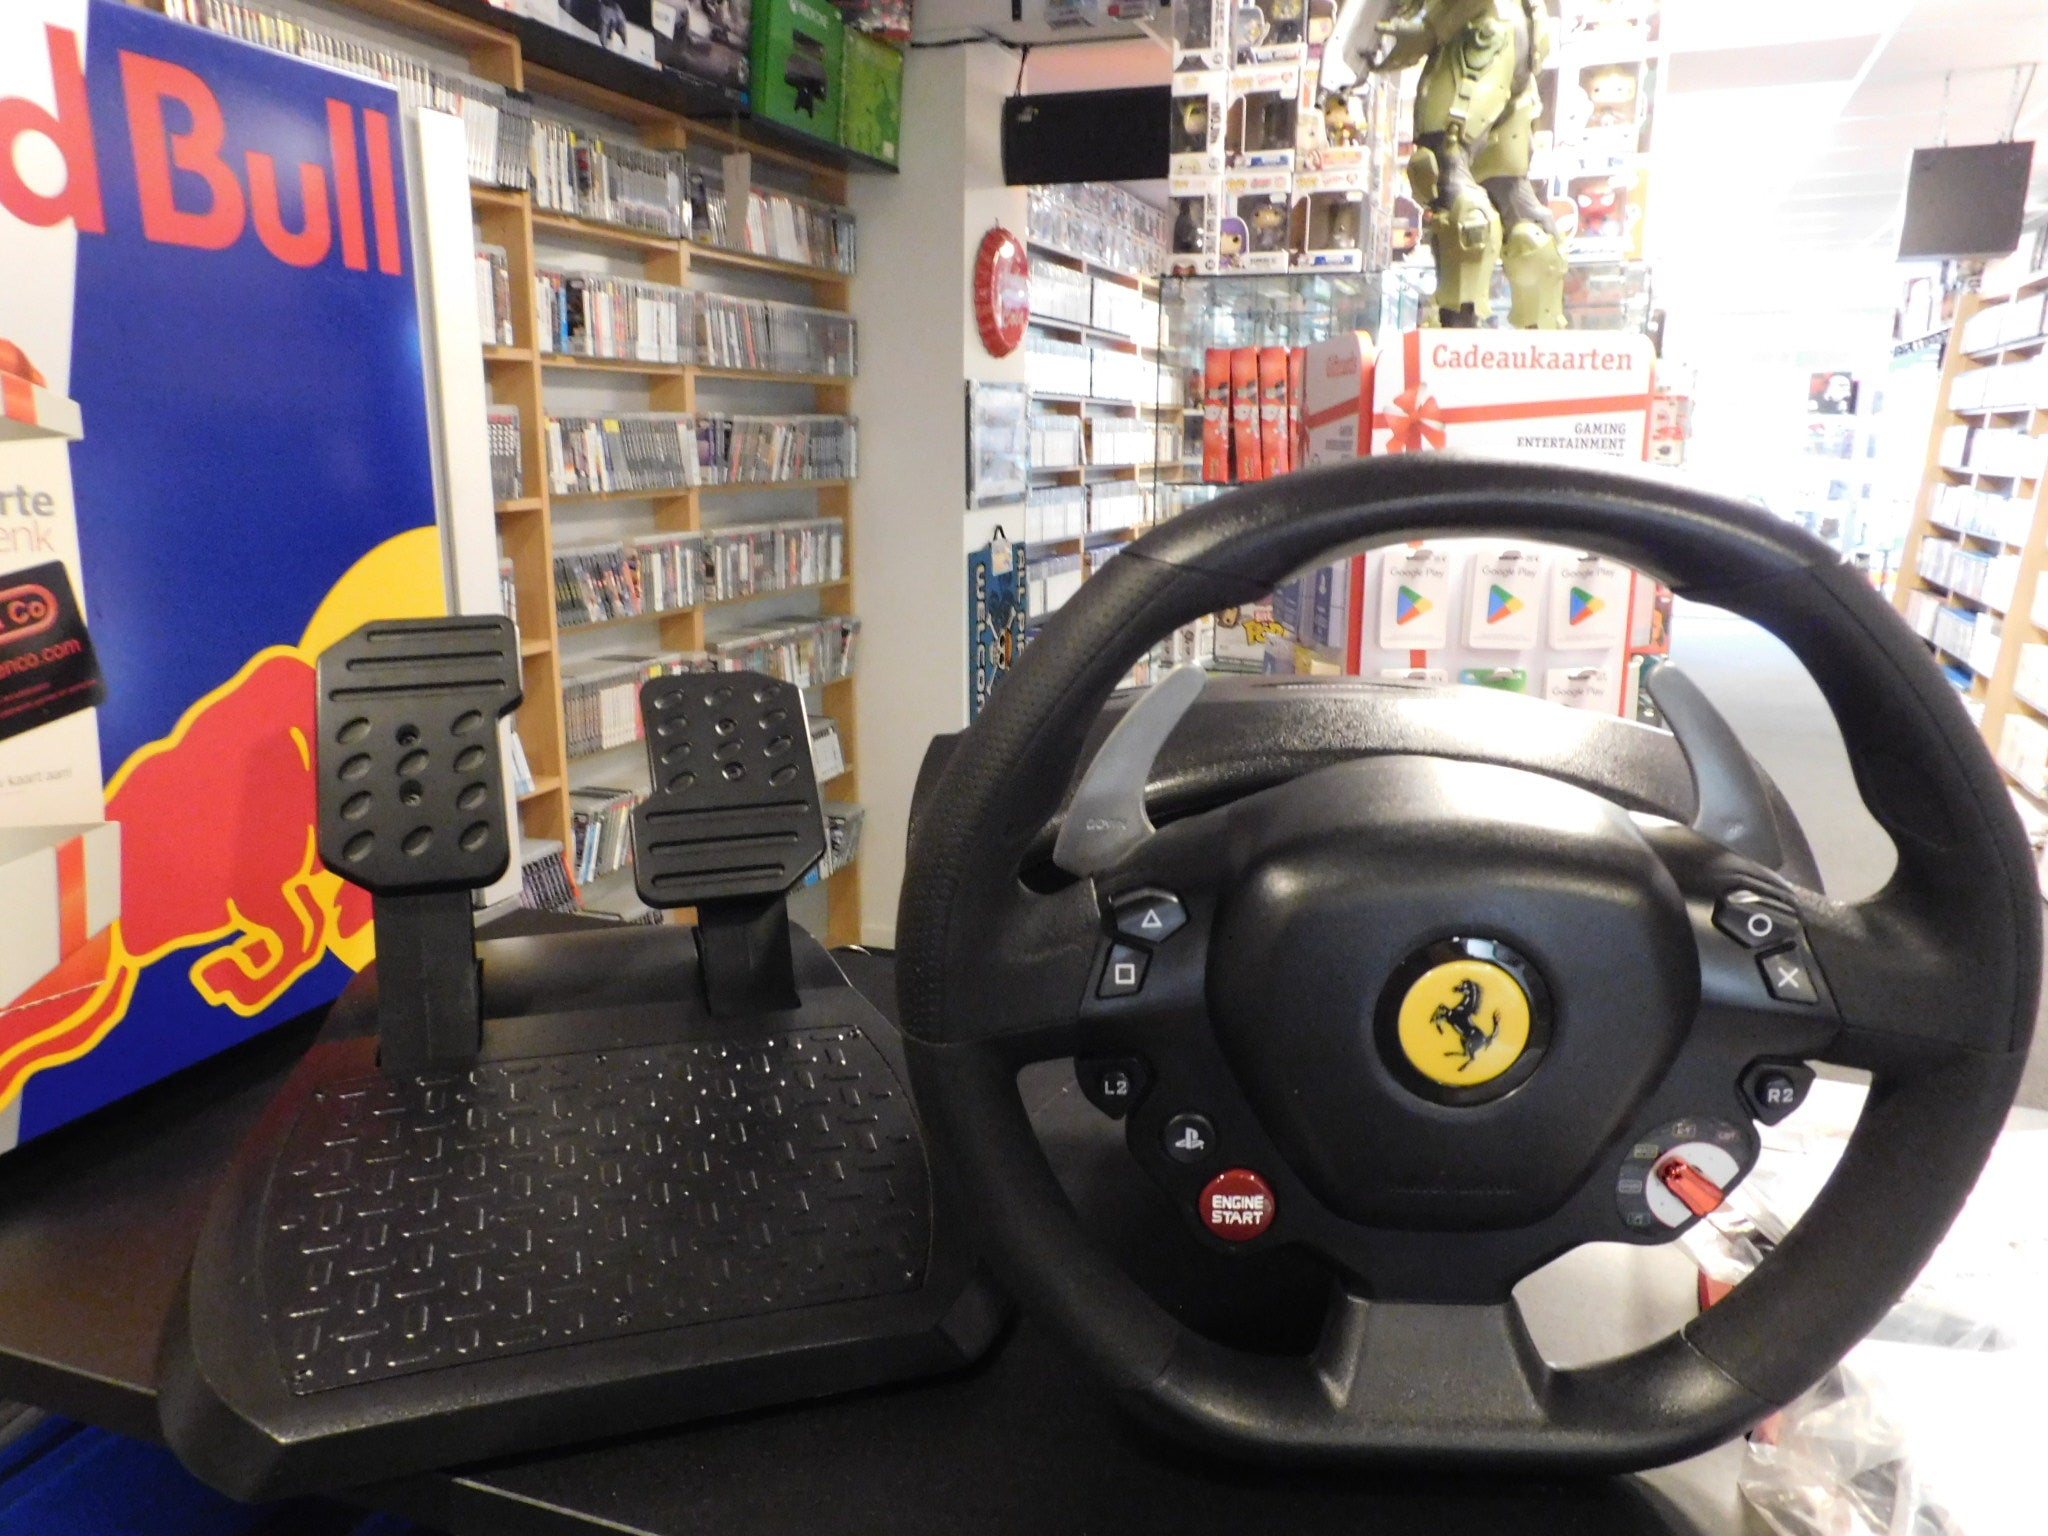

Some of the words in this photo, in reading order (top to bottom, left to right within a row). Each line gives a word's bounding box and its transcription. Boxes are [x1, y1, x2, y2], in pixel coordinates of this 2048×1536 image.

[118, 48, 402, 276] Bull
[1432, 343, 1633, 371] Cadeaukaarten
[1574, 422, 1627, 436] GAMING
[1516, 436, 1626, 451] ENTERTAINMENT
[1390, 566, 1423, 579] Google
[1425, 567, 1445, 579] Play
[1482, 564, 1516, 578] Google
[1518, 566, 1538, 579] Play
[1562, 567, 1594, 579] Google
[1596, 567, 1616, 579] Play
[8, 600, 47, 624] Co
[1552, 685, 1584, 696] Google
[1587, 686, 1605, 697] Play
[1104, 1080, 1128, 1096] L2
[1766, 1087, 1794, 1104] R2
[1211, 1194, 1265, 1210] ENGINE
[1211, 1210, 1264, 1225] START
